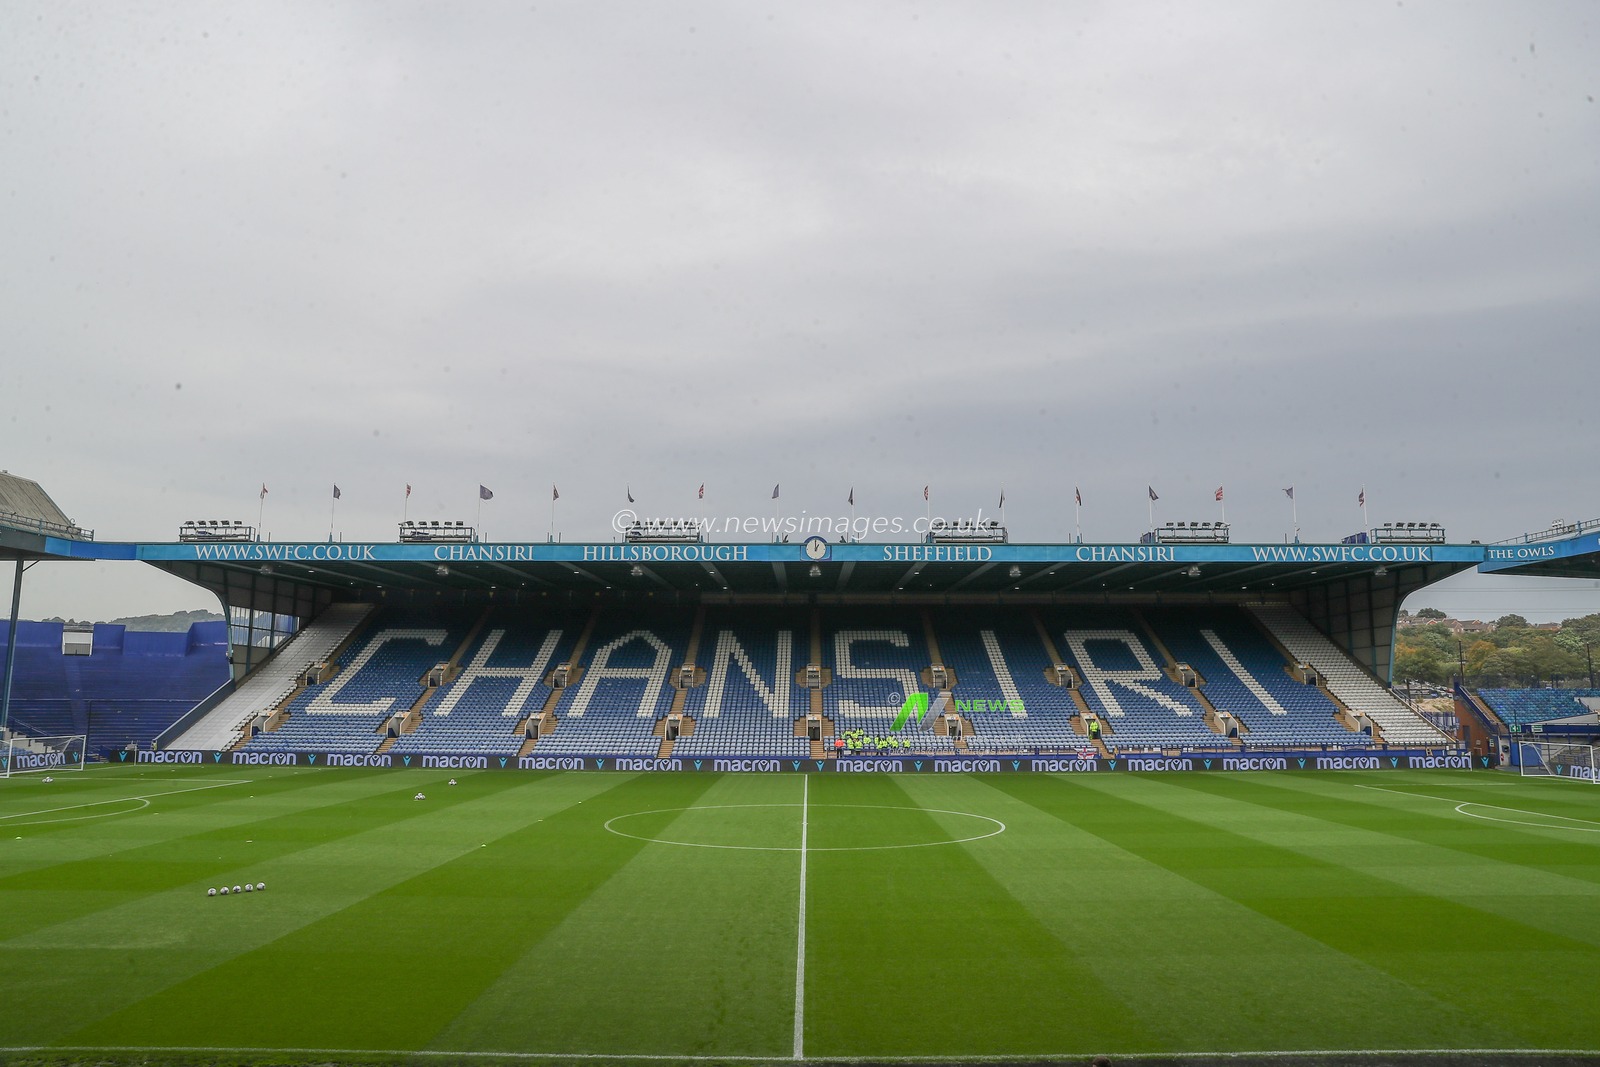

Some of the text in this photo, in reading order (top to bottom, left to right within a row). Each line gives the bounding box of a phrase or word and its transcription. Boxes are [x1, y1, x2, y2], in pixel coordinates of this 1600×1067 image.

[194, 545, 1431, 562] WWW.SWFC.CO.UK CHANSIRI HILLSBOROUGH SHEFFIELD CHANSIRI WWW.SWFC.CO.UK
[1488, 546, 1555, 559] THE OWLS
[16, 753, 66, 768] macron
[138, 750, 1472, 772] macron macron macron macron macron macron macron macron macron macron macron macron macron macron
